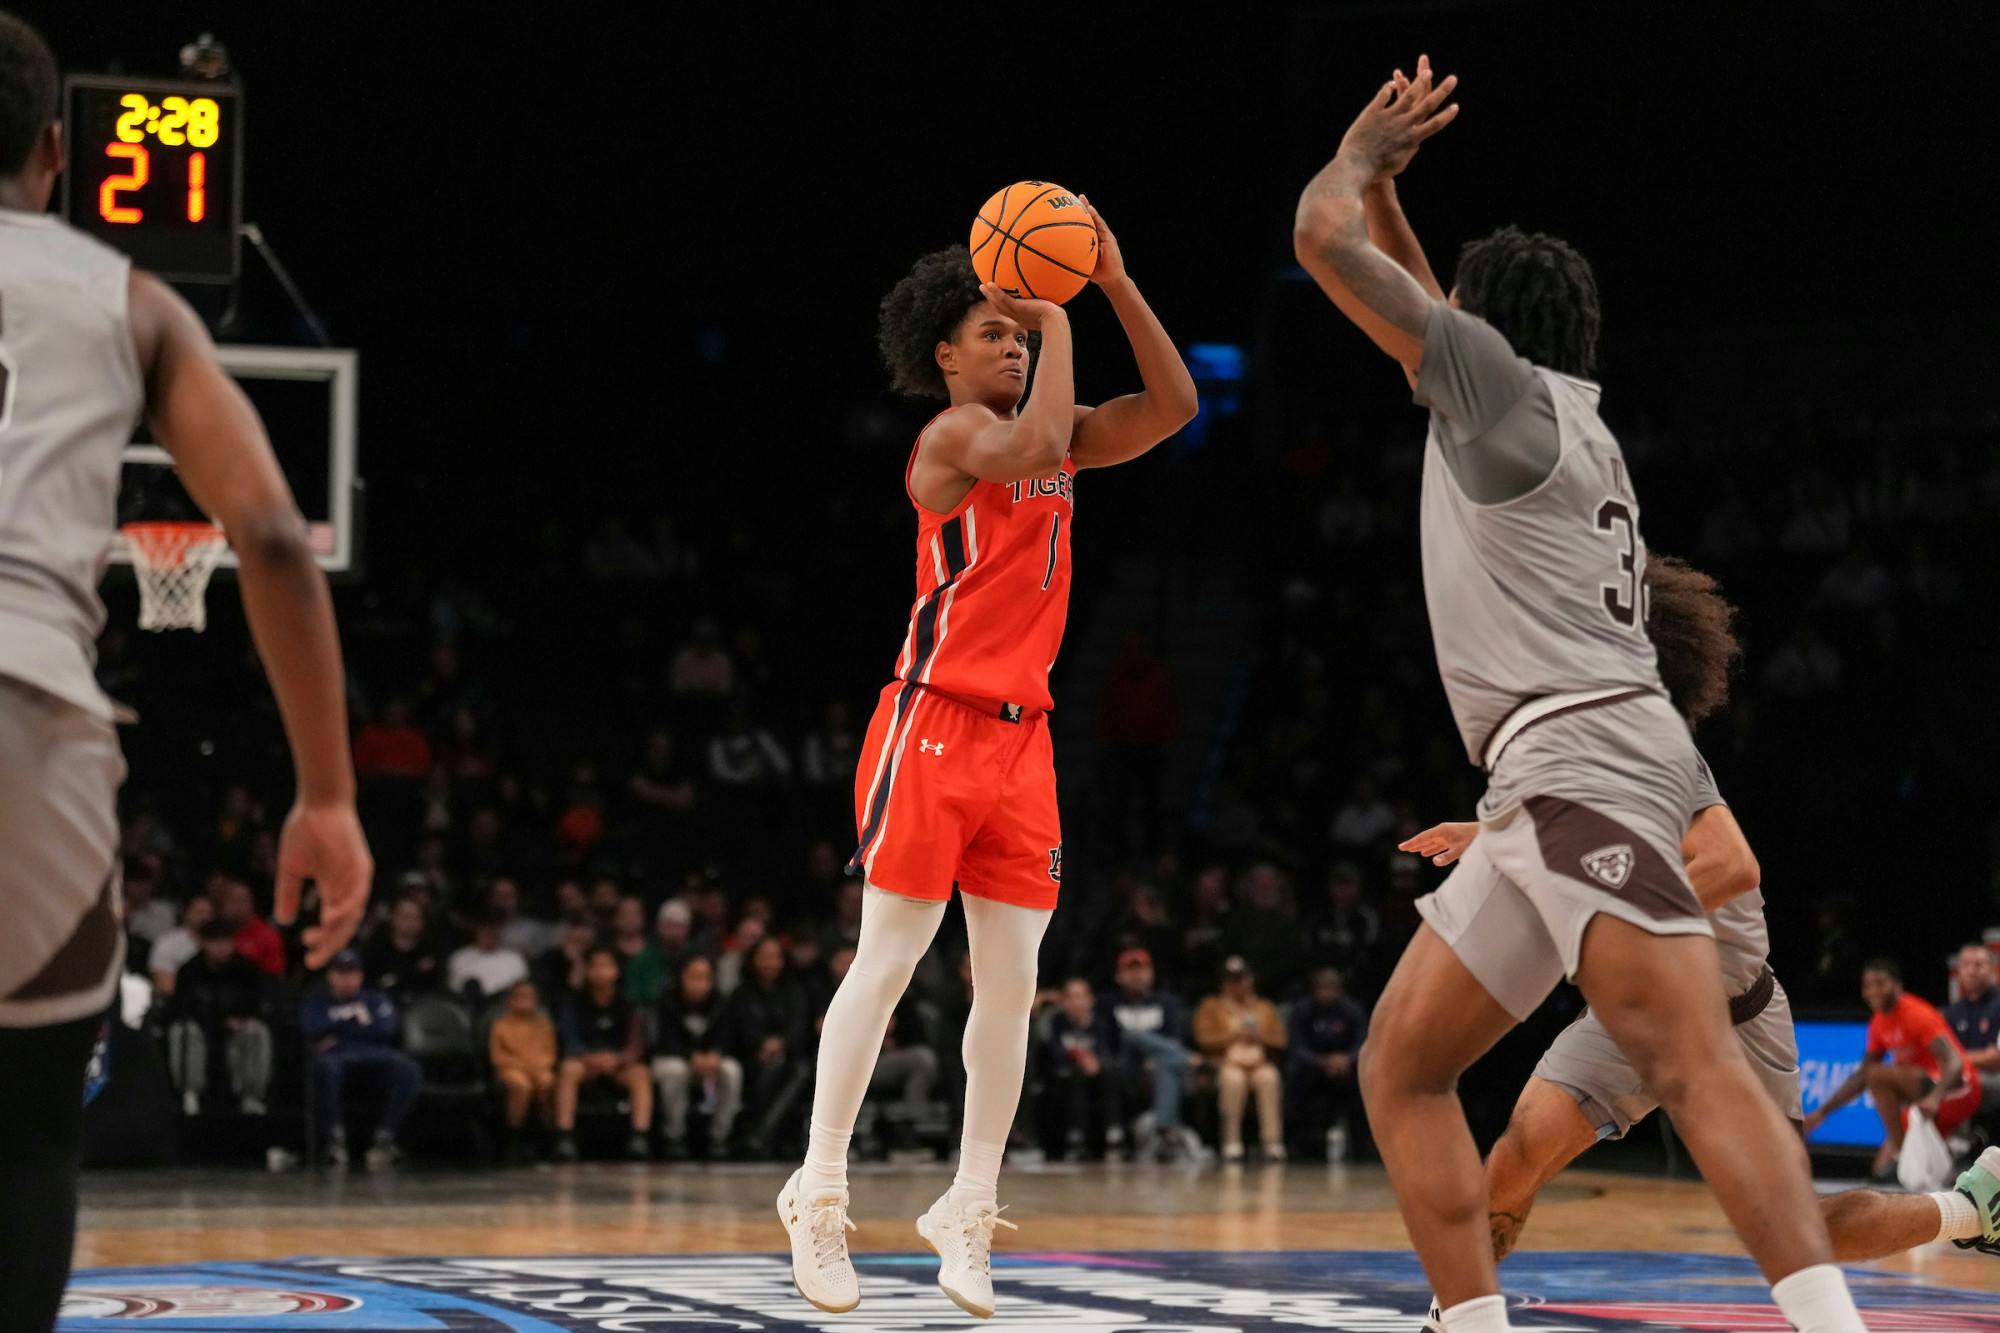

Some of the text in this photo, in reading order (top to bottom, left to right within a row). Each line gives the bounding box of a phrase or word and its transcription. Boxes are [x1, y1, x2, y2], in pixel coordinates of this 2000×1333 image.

[116, 93, 219, 148] 2:28
[1041, 511, 1059, 591] 1
[1593, 496, 1650, 632] 3
